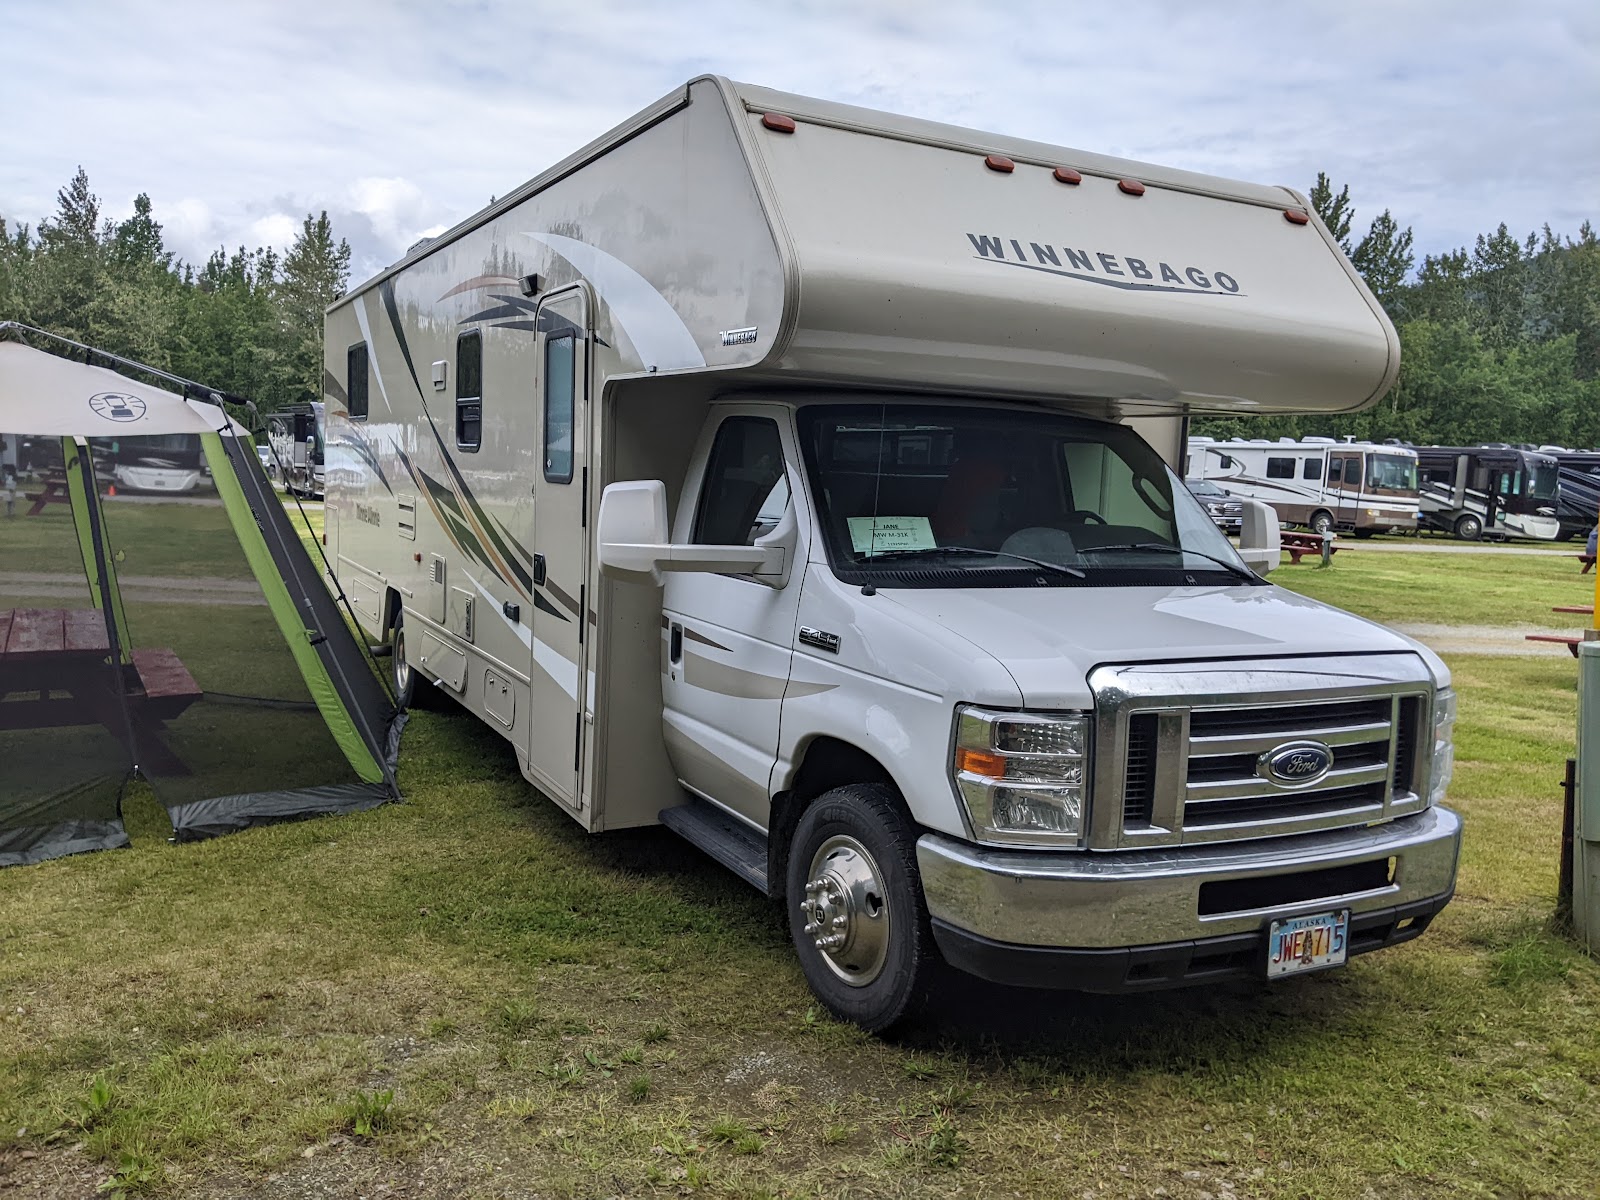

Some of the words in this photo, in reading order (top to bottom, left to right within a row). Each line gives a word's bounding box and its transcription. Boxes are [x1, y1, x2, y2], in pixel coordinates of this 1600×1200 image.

[966, 232, 1240, 293] WINNEBAGO
[1287, 753, 1320, 774] Ford
[1292, 917, 1327, 930] ALASKA
[1314, 922, 1345, 957] 715
